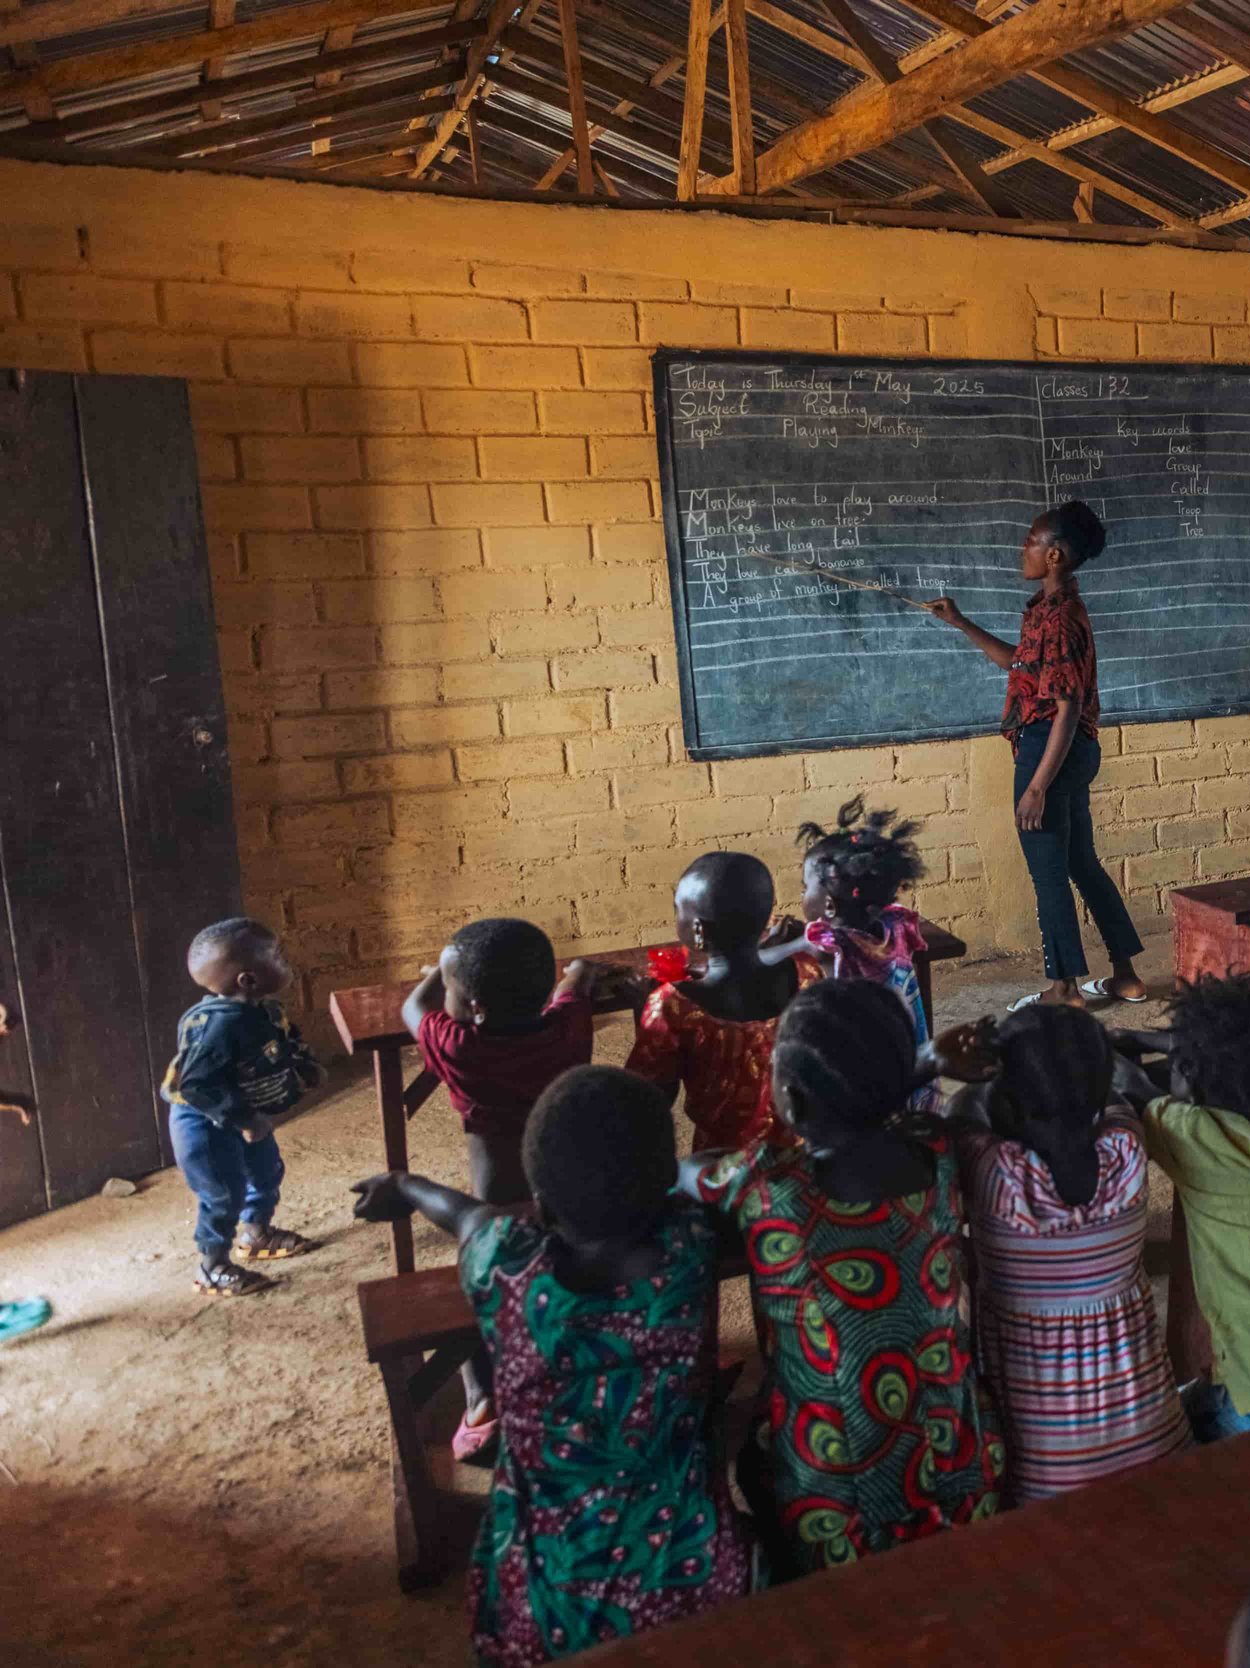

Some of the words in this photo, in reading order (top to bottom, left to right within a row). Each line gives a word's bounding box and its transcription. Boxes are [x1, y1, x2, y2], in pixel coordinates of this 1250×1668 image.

[674, 365, 725, 401] Today
[742, 379, 752, 389] is
[764, 369, 832, 403] Thursday
[874, 372, 910, 404] May
[933, 377, 984, 396] 2025
[1042, 376, 1088, 398] Classes
[679, 391, 750, 427] Subject
[802, 391, 867, 427] Reading
[683, 419, 724, 450] Topic
[783, 415, 838, 448] Playing
[1117, 417, 1138, 447] Key
[1152, 414, 1191, 436] words
[1168, 437, 1192, 454] love
[1051, 438, 1104, 469] Monkeys
[1166, 457, 1202, 480] Group
[1050, 460, 1093, 485] Around
[1171, 476, 1210, 495] Called
[690, 489, 757, 520] Monkeys
[772, 484, 797, 505] love
[814, 484, 827, 505] to
[843, 485, 872, 515] play
[1054, 483, 1073, 503] live
[686, 511, 761, 543] Monkeys
[771, 505, 796, 531] live
[810, 518, 825, 527] on
[1174, 500, 1201, 525] Troop
[1180, 523, 1205, 537] Tree
[685, 537, 727, 571] They
[734, 535, 771, 554] have
[788, 532, 814, 564] long
[692, 561, 728, 593] They
[736, 556, 759, 579] love
[702, 582, 716, 607] A
[729, 592, 763, 613] group
[770, 578, 784, 600] of
[795, 574, 840, 606] monkey
[866, 572, 901, 590] called
